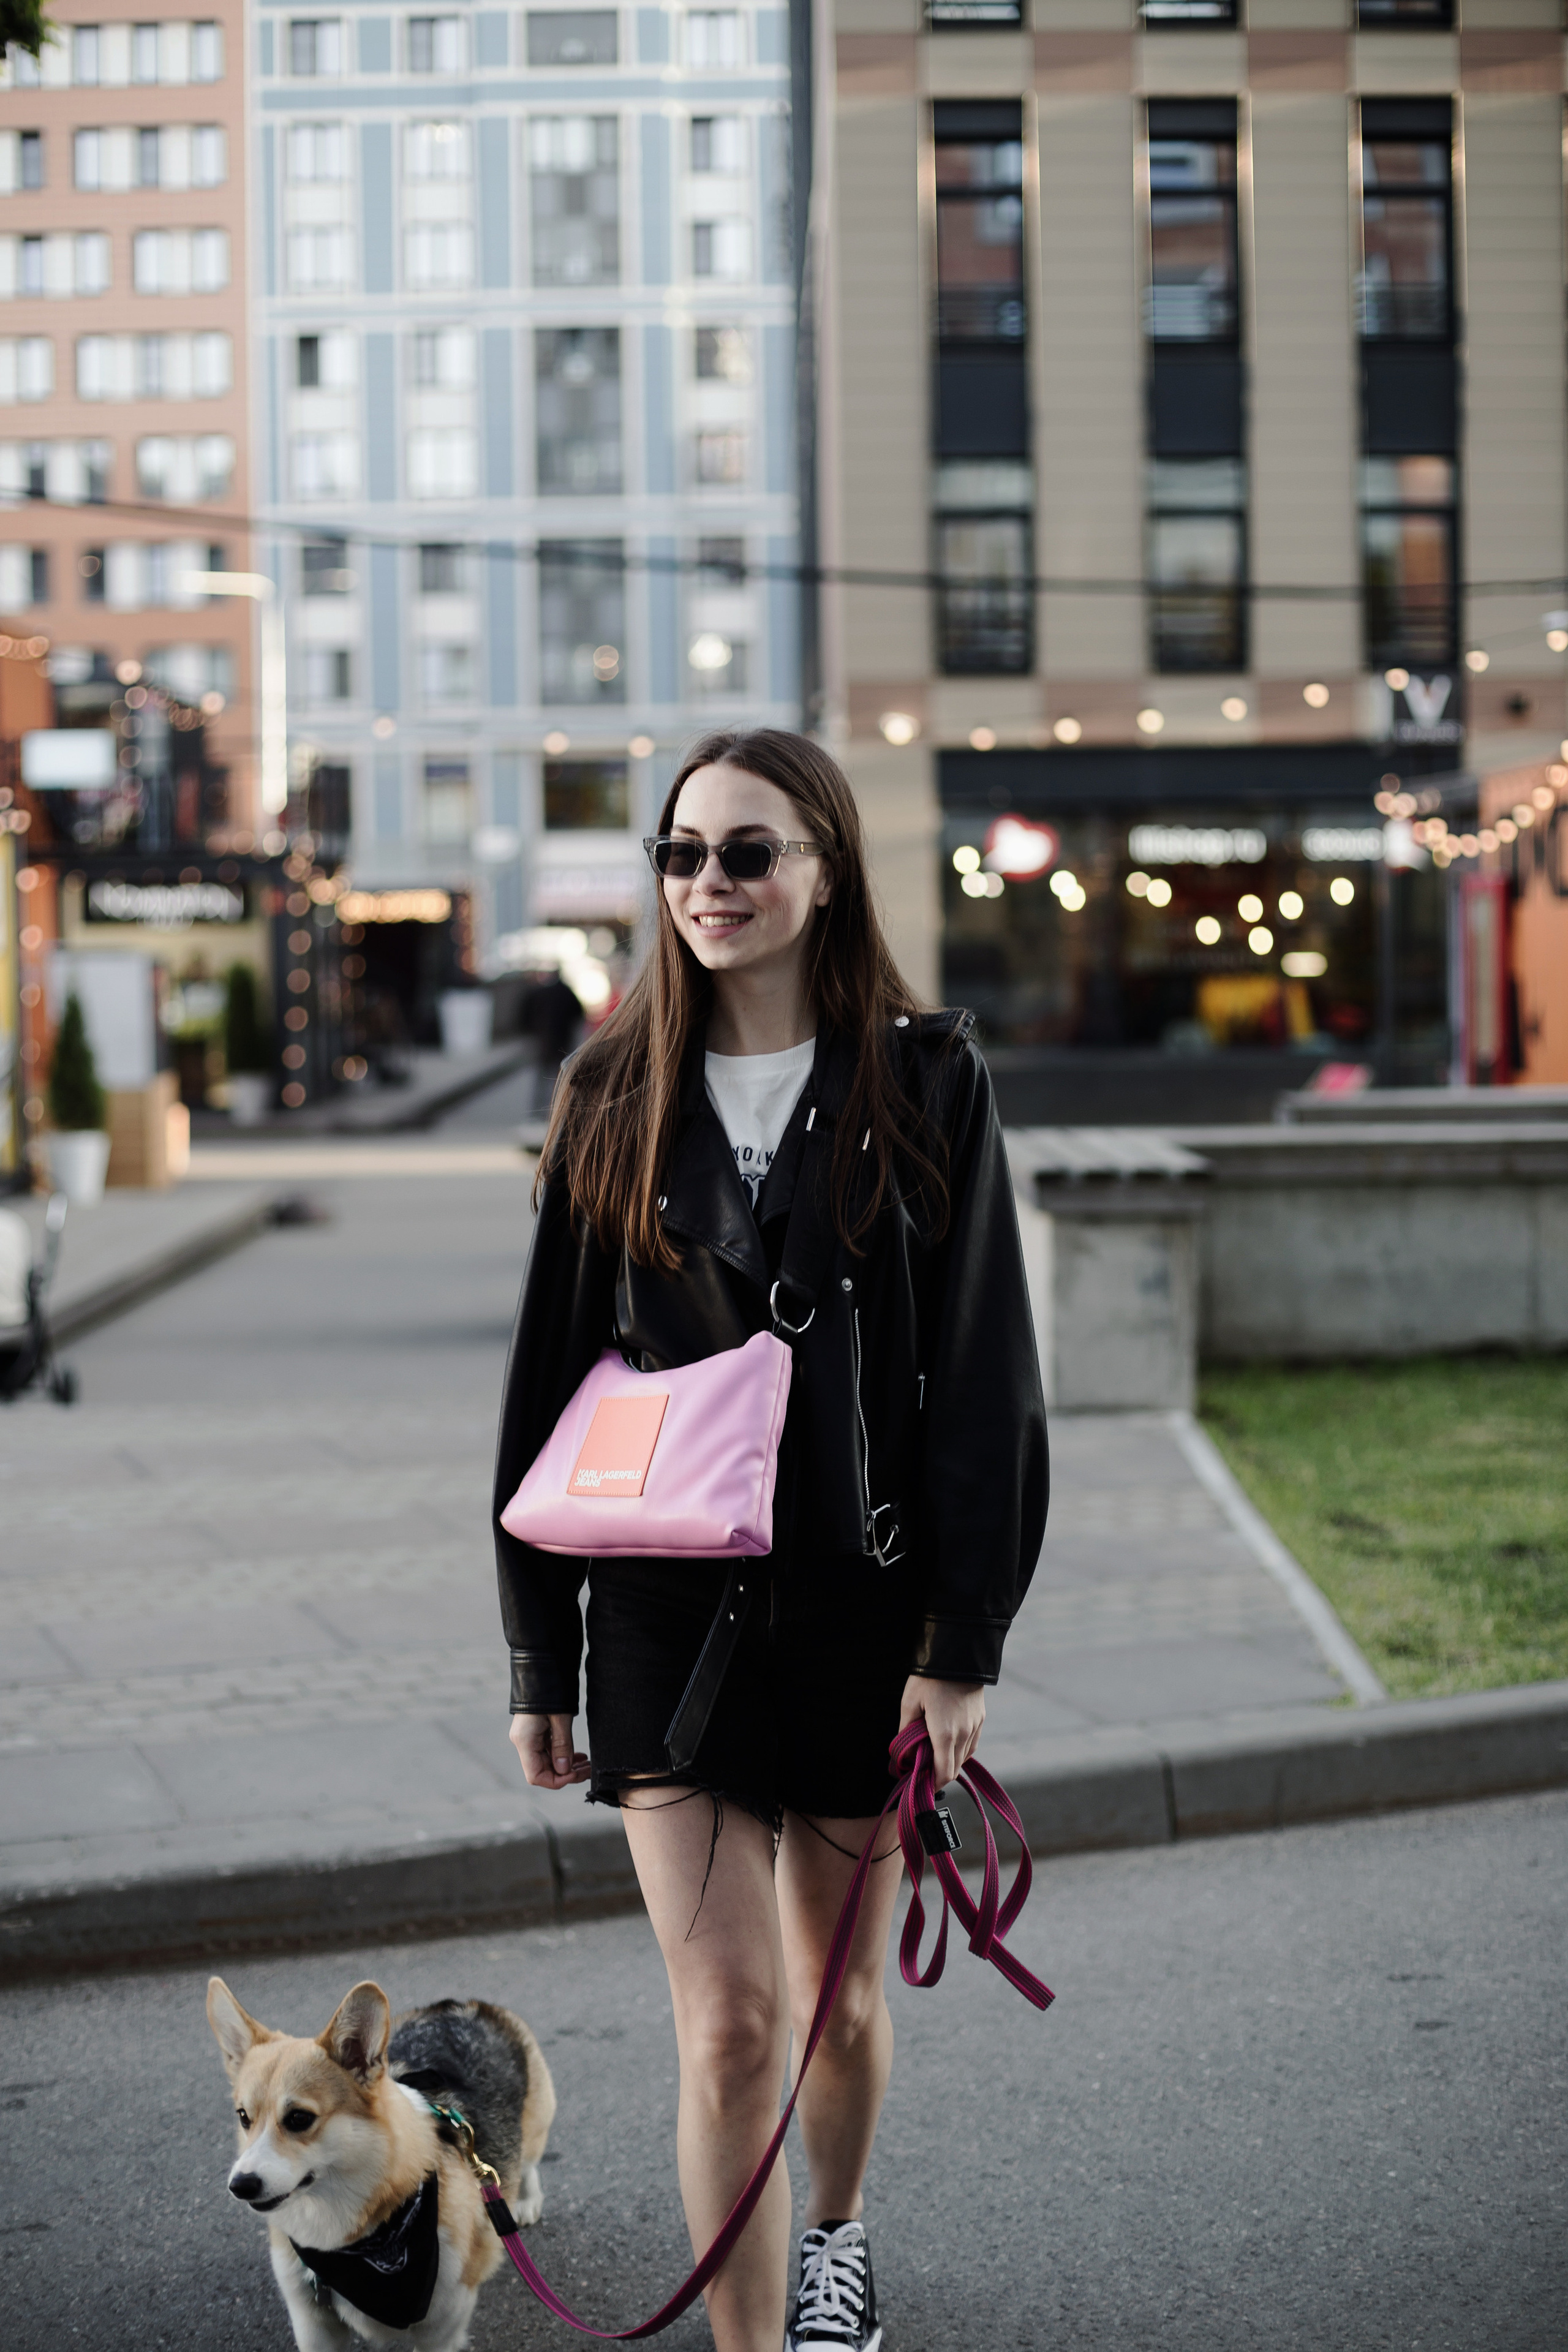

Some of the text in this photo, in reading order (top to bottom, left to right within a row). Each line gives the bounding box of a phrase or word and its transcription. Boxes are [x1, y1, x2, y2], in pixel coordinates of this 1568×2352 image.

[578, 1469, 642, 1480] KARL LAGERFELD
[574, 1477, 601, 1487] JEANS
